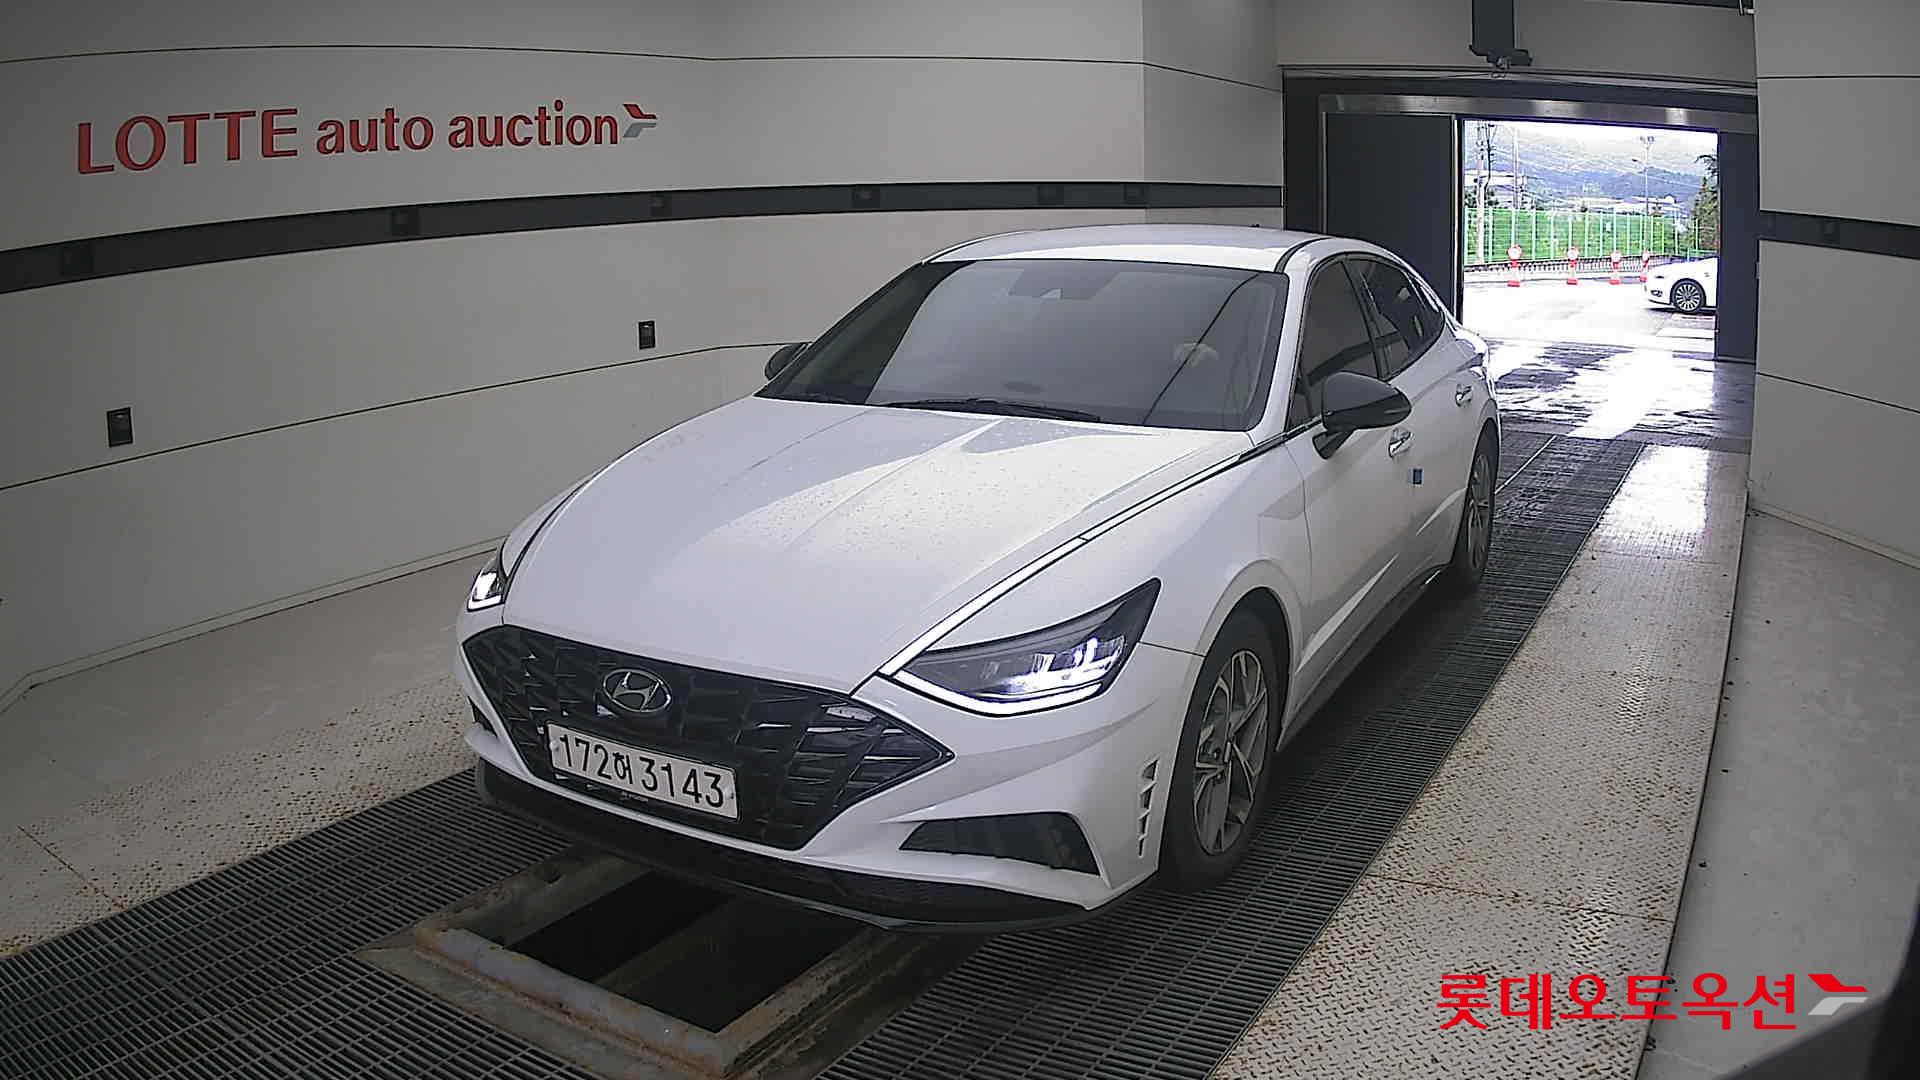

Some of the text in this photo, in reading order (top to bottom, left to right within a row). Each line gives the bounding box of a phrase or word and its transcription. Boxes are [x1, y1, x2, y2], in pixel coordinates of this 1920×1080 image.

[78, 99, 619, 174] LOTTE auto auction
